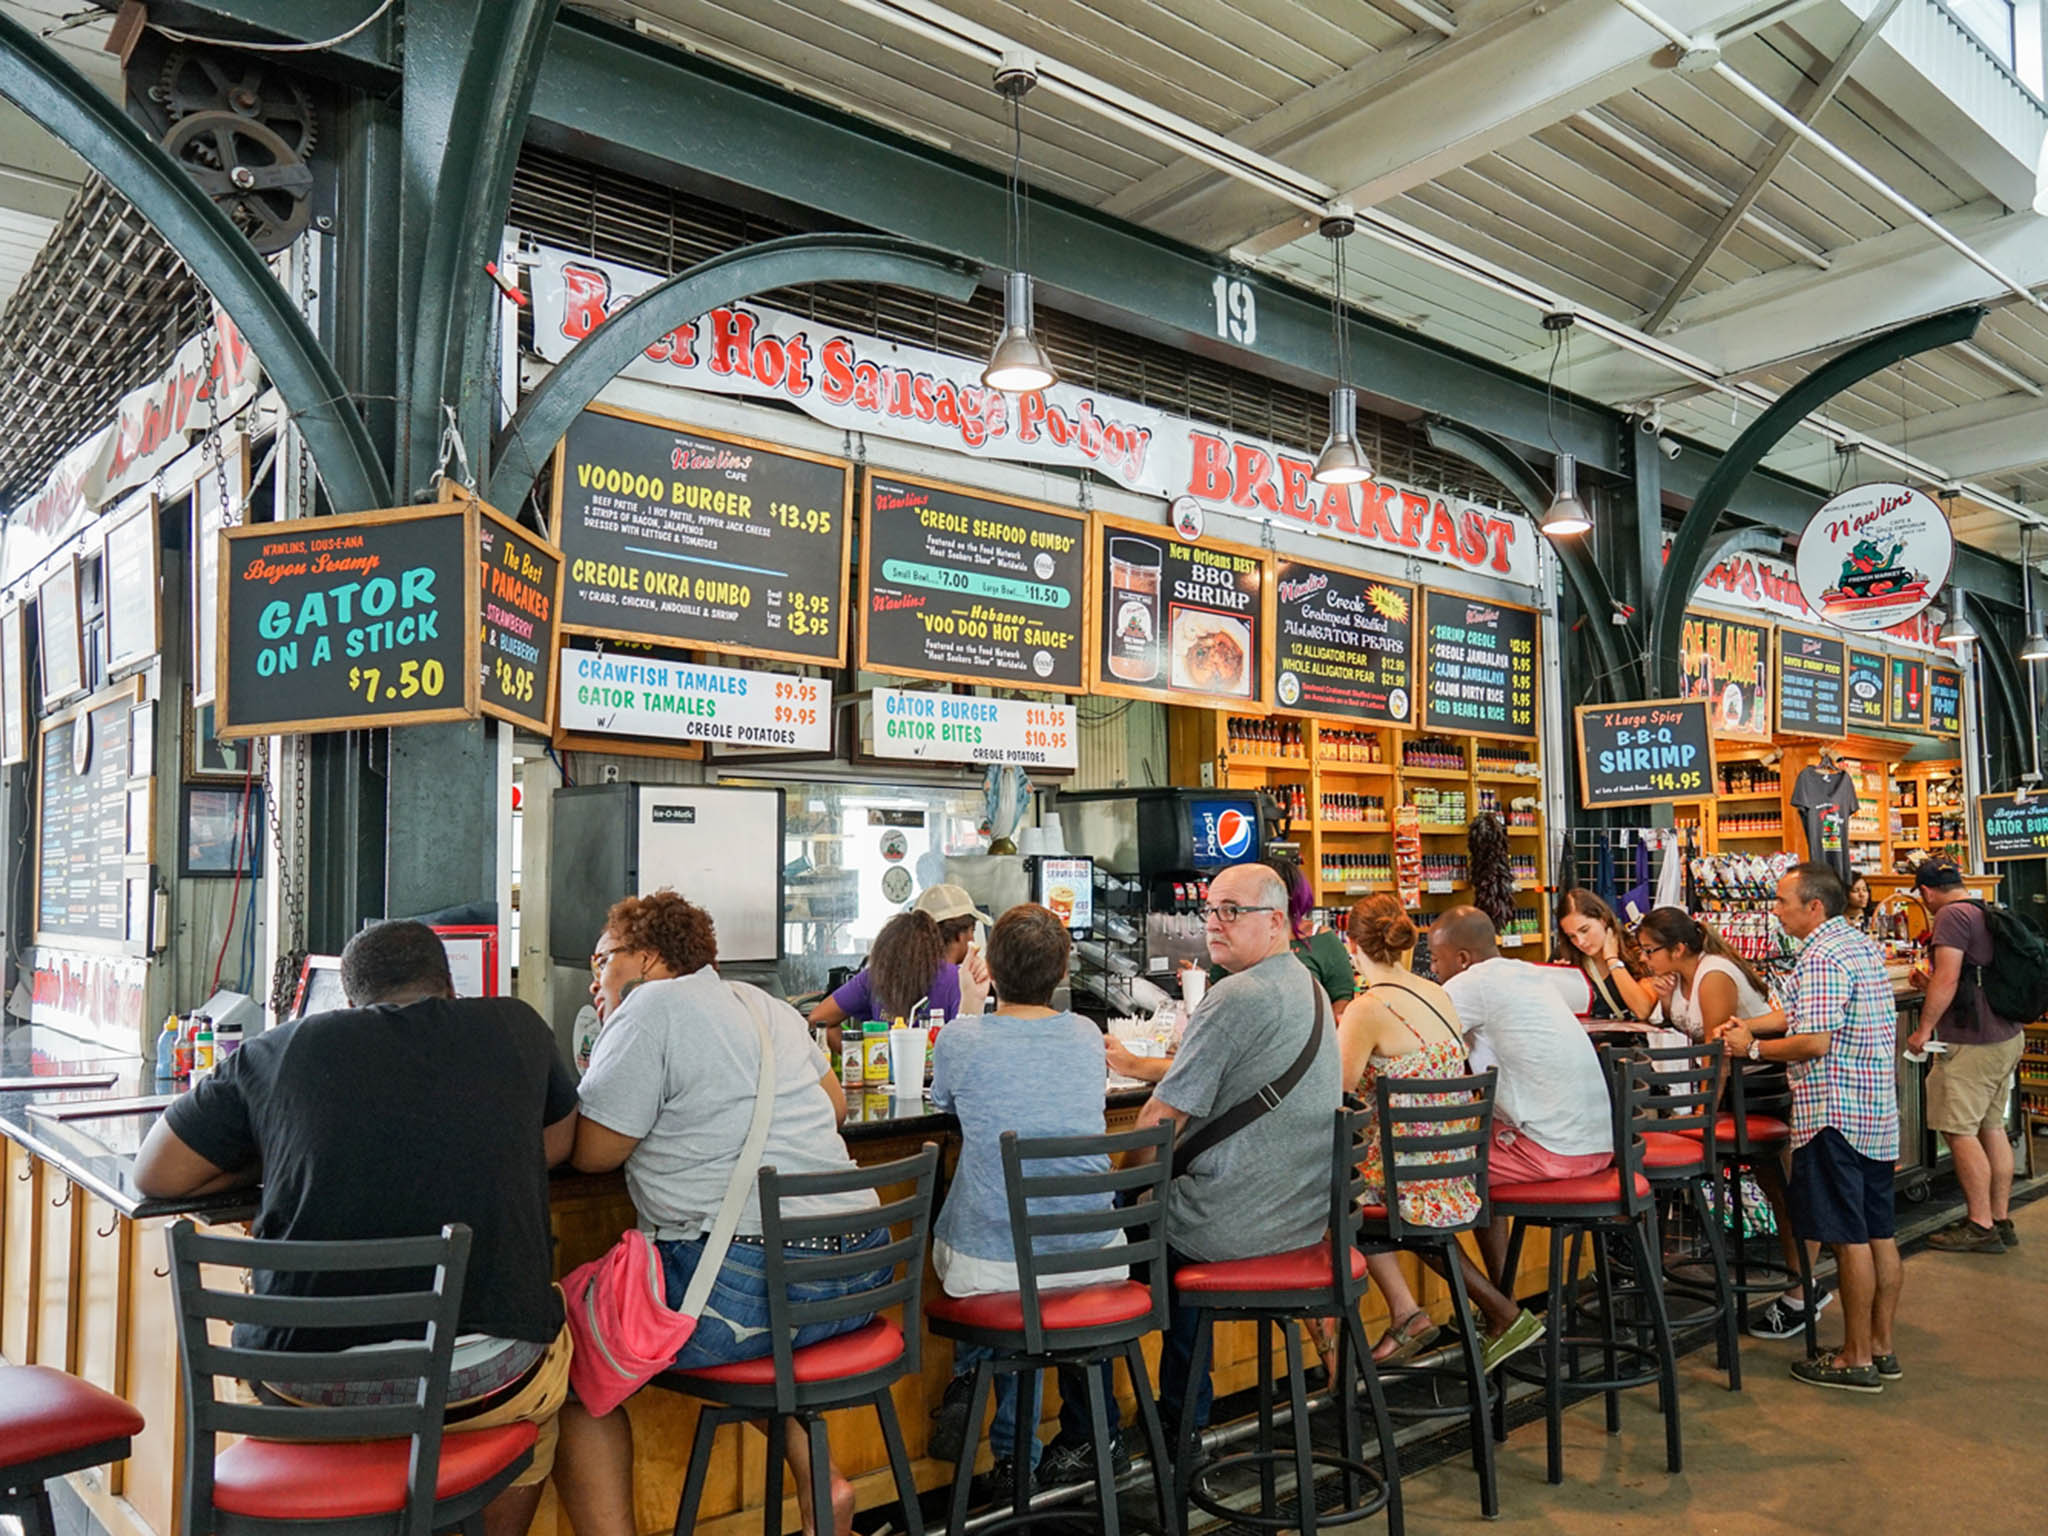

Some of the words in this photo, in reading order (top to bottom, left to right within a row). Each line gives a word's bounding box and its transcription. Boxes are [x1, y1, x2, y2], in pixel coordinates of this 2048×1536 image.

[1212, 275, 1258, 345] 19
[709, 307, 813, 398] Hot
[820, 336, 1010, 447] Sausage
[725, 470, 748, 482] CAFE
[578, 463, 664, 502] VOODOO
[671, 482, 752, 519] BURGER
[1186, 429, 1516, 574] BREAKFAST
[584, 516, 619, 532] DRESSED
[620, 524, 640, 536] WITH
[641, 527, 672, 542] LETTUCE
[592, 506, 618, 522] STRIPS
[620, 511, 630, 523] OF
[592, 494, 611, 506] BEEF
[614, 498, 638, 513] PATTIE
[699, 515, 724, 530] PEPPER
[726, 521, 744, 533] JACK
[745, 524, 772, 538] CHEESE
[769, 501, 832, 535] $13.95
[310, 535, 364, 552] LOUS-E-ANA
[972, 520, 1026, 545] SEAFOOD
[243, 558, 307, 584] Bayou
[311, 553, 380, 576] Swamp
[504, 542, 520, 571] The
[521, 553, 544, 584] Best
[1169, 542, 1190, 561] New
[1192, 548, 1231, 572] Orleans
[1233, 556, 1256, 574] BEST
[572, 558, 640, 591] CREOLE
[644, 570, 690, 600] OKRA
[694, 578, 752, 608] GUMBO
[938, 570, 969, 588] $7.00
[1025, 585, 1058, 603] $11.50
[1192, 564, 1234, 590] BBQ
[1848, 574, 1874, 583] FRENCH
[1874, 570, 1901, 580] MARKET
[258, 567, 436, 639] GATOR
[490, 567, 550, 622] PANCAKES
[588, 590, 619, 606] CRABS,
[621, 596, 658, 612] CHICKEN,
[660, 601, 701, 617] ANDOUILLE
[788, 592, 830, 614] $8.95
[1173, 580, 1250, 610] SHRIMP
[1326, 589, 1366, 613] Creole
[487, 602, 534, 640] STRAWBERRY
[787, 610, 829, 636] 13.95
[958, 620, 988, 639] DOO
[992, 624, 1019, 643] HOT
[1301, 604, 1350, 628] Crabmeat
[1353, 614, 1388, 633] Stuffed
[256, 642, 298, 678] ON
[311, 636, 332, 667] A
[346, 609, 438, 658] STICK
[500, 632, 540, 664] BLUEBERRY
[1362, 634, 1404, 654] PEARS
[1436, 624, 1466, 644] SHRIMP
[1467, 631, 1496, 648] CREOLE
[1291, 642, 1304, 656] 1/2
[1304, 644, 1346, 662] ALLIGATOR
[1346, 652, 1368, 666] PEAR
[1435, 644, 1465, 662] CREOLE
[1466, 648, 1510, 669] JAMBALAYA
[1512, 656, 1531, 672] 9.95
[349, 658, 444, 703] $7.50
[496, 656, 534, 702] $8.95
[578, 658, 668, 687] CRAWFISH
[676, 670, 748, 696] TAMALES
[775, 682, 818, 702] $9.95
[1282, 658, 1311, 674] WHOLE
[1312, 660, 1354, 680] ALLIGATOR
[1354, 670, 1375, 684] PEAR
[1435, 662, 1460, 680] CAJUN
[1462, 666, 1505, 686] JAMBALAYA
[1512, 674, 1531, 690] 9.95
[578, 685, 635, 709] GATOR
[643, 692, 716, 718] TAMALES
[775, 704, 817, 725] $9.95
[1434, 680, 1460, 698] CAJUN
[1462, 684, 1484, 702] DIRTY
[1486, 690, 1504, 704] RICE
[1512, 692, 1531, 707] 9.95
[886, 695, 935, 718] GATOR
[941, 700, 998, 722] BURGER
[1026, 708, 1066, 727] $11.95
[1435, 700, 1450, 714] RED
[1453, 702, 1478, 719] BEANS
[1480, 707, 1486, 719] &
[1487, 706, 1505, 721] RICE
[1512, 709, 1531, 724] 9.95
[1615, 714, 1646, 728] Large
[1650, 710, 1684, 726] Spicy
[597, 713, 617, 728] w/
[686, 721, 733, 739] CREOLE
[738, 726, 796, 744] POTATOES
[886, 719, 936, 740] GATOR
[942, 724, 982, 744] BITES
[1024, 730, 1067, 748] $10.95
[1616, 728, 1672, 746] B-B-Q
[972, 748, 1004, 760] CREOLE
[1006, 749, 1046, 763] POTATOES
[1600, 744, 1696, 774] SHRIMP
[1650, 770, 1702, 790] $14.95
[1202, 812, 1216, 857] pepsi
[1986, 818, 2024, 837] GATOR
